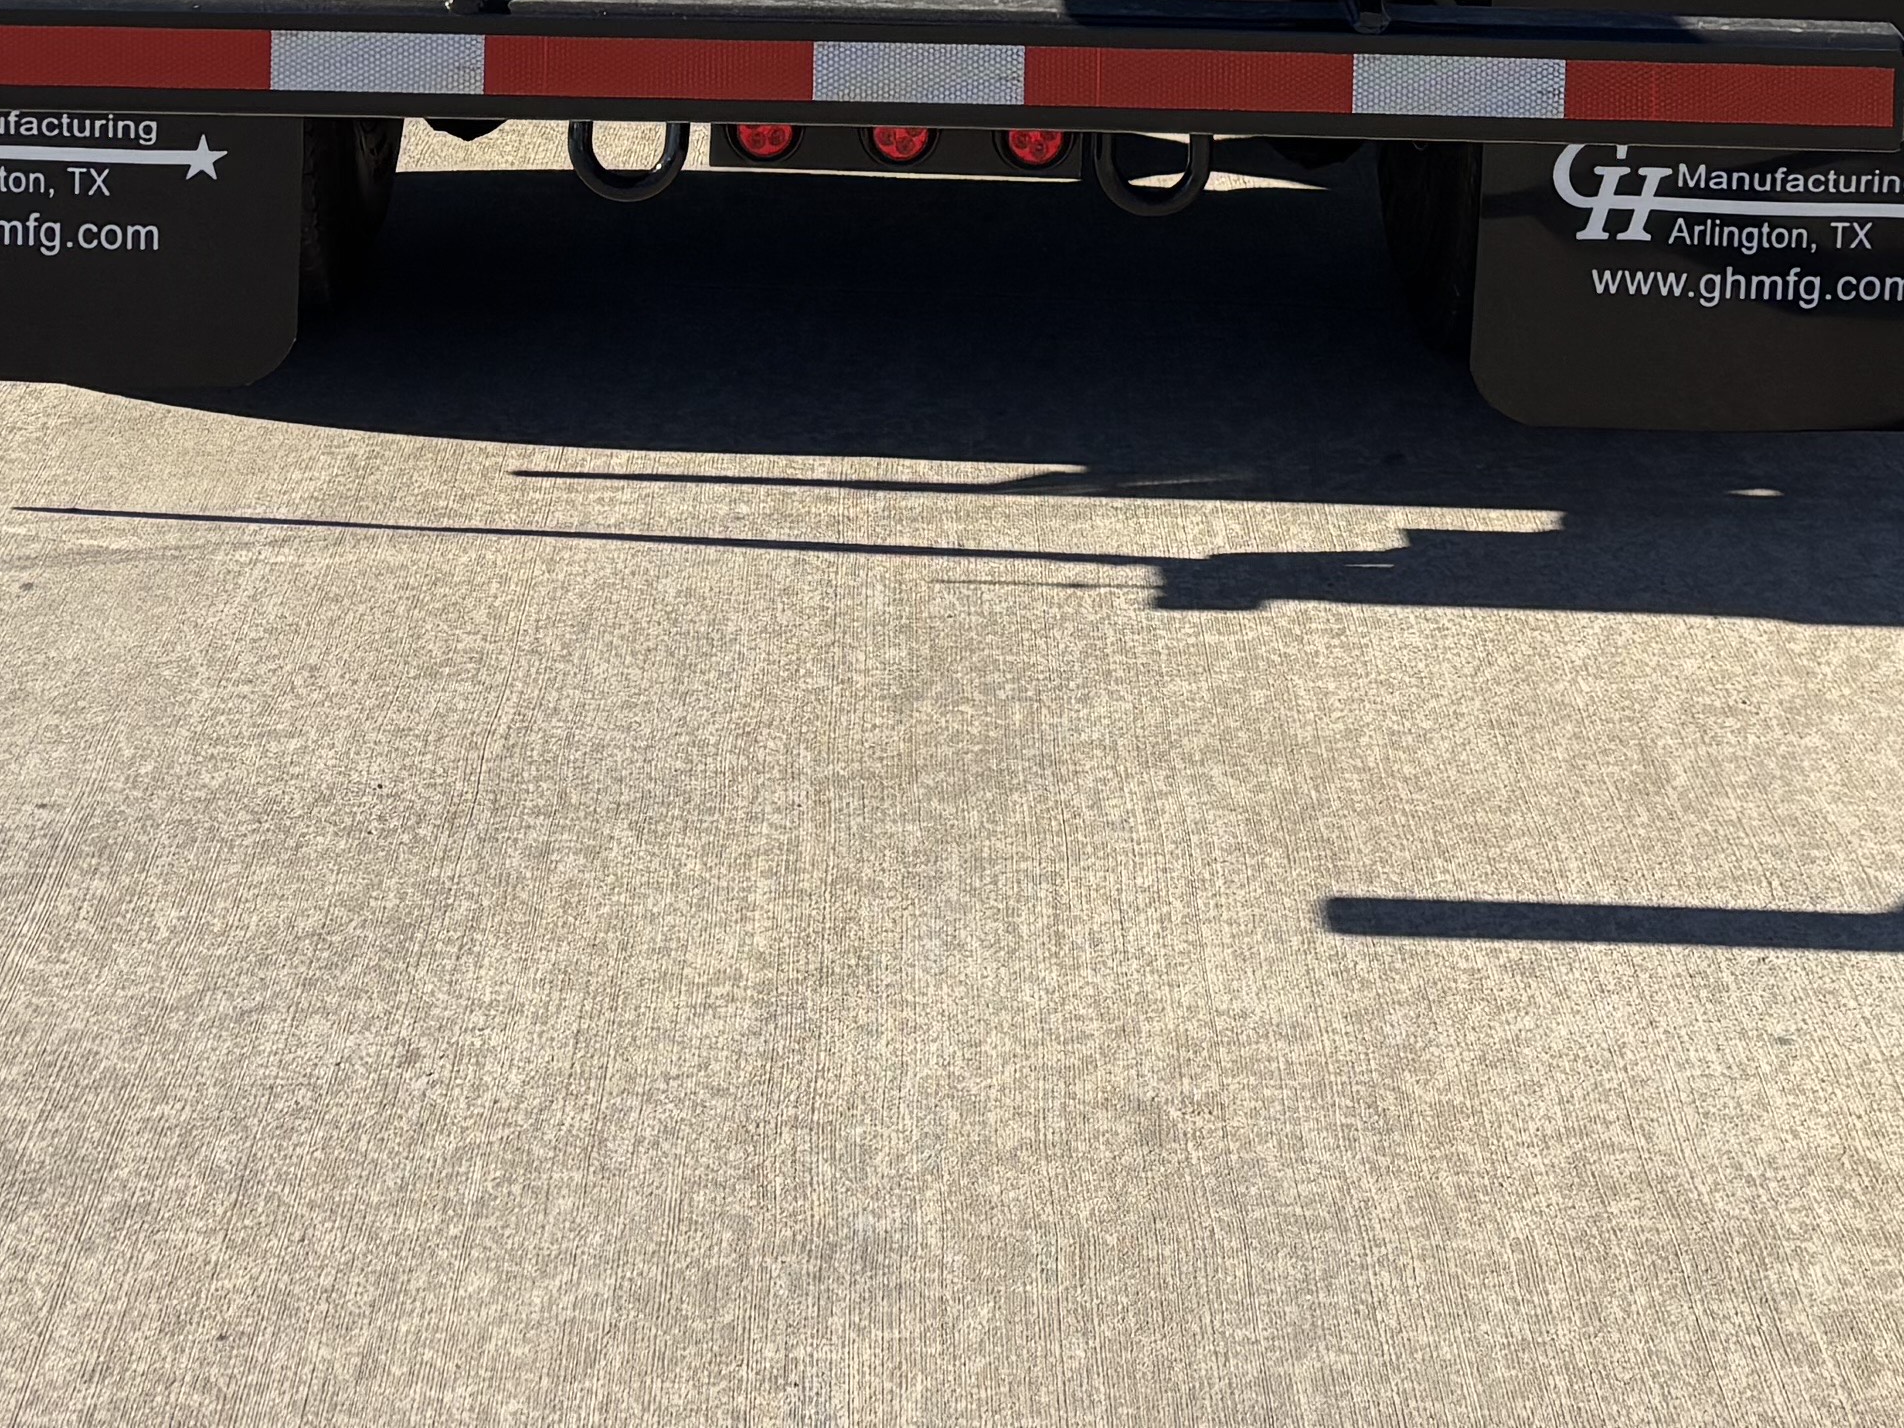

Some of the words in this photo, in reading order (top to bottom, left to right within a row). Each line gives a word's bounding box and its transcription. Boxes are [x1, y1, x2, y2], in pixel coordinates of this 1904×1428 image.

[67, 167, 111, 197] TX
[1668, 218, 1817, 255] Arlington,
[1830, 222, 1873, 250] TX
